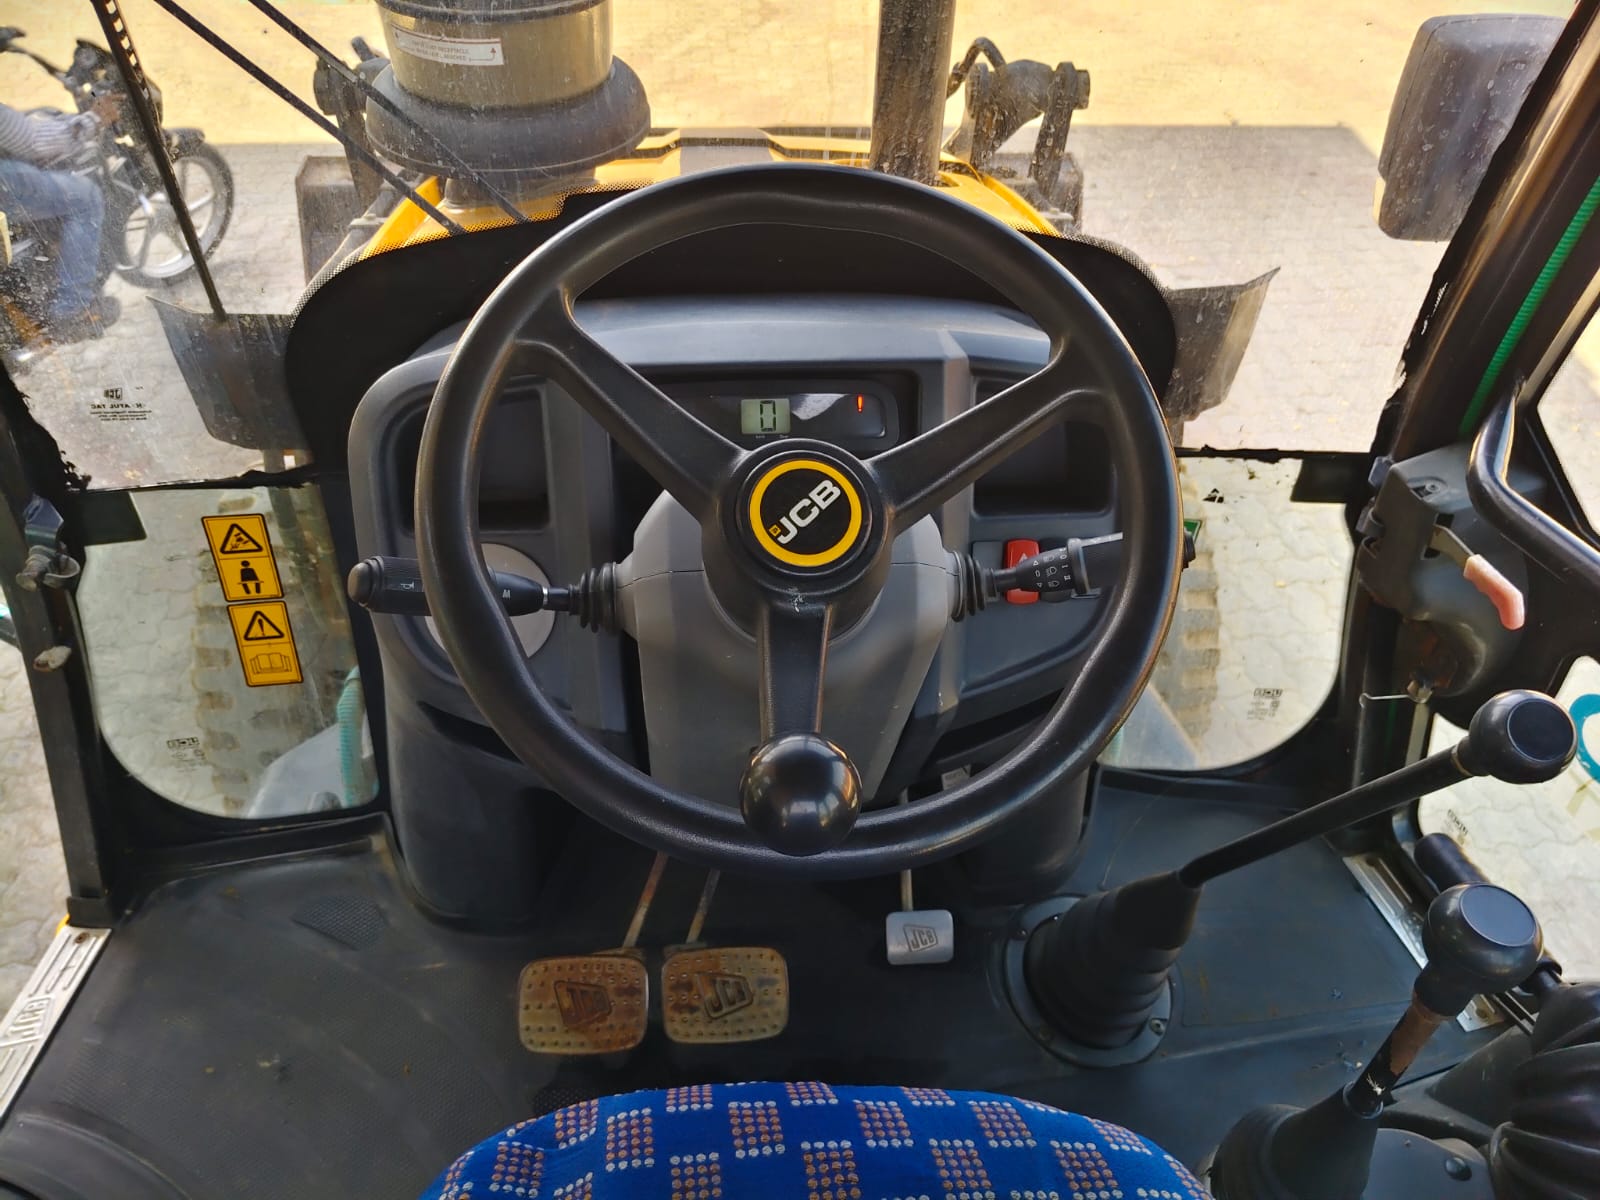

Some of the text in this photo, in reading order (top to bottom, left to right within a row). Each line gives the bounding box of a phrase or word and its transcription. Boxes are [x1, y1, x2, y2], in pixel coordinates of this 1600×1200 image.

[760, 400, 776, 432] 0
[777, 480, 841, 544] JCB
[911, 929, 934, 949] JCB
[9, 1001, 48, 1038] JCB
